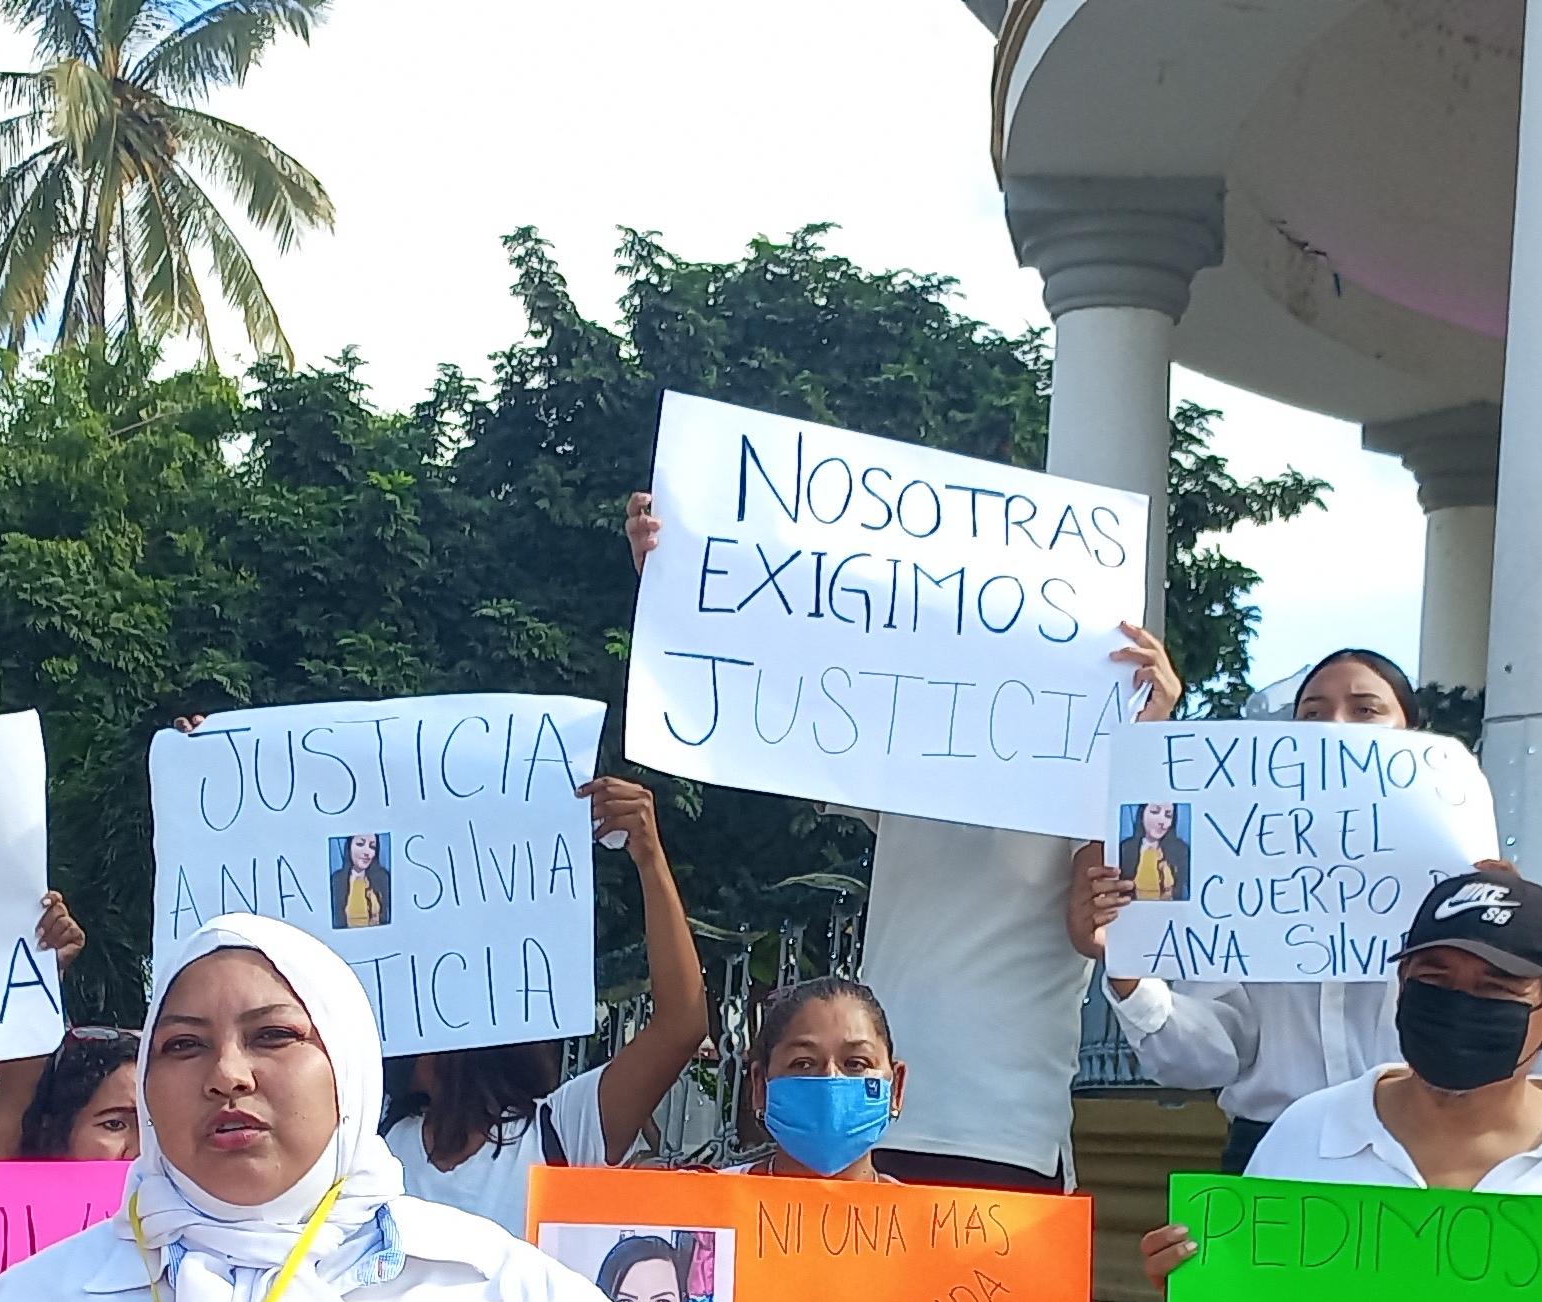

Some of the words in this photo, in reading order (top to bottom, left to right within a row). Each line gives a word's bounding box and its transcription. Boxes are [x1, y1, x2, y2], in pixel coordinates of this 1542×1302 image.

[738, 432, 1126, 568] NOSOTRAS
[699, 537, 1079, 643] EXIGIMOS
[664, 651, 1123, 763] JUSTICIA
[188, 713, 581, 831] JUSTICIA
[1163, 732, 1467, 806] EXIGIMOS
[1204, 803, 1315, 860] VER
[1338, 803, 1396, 860] EL
[170, 853, 314, 939] ANA
[405, 820, 577, 911] SILVIA
[1201, 864, 1401, 919] CUERPO
[1481, 907, 1514, 925] SB
[1143, 920, 1251, 980] ANA
[758, 1200, 803, 1259] NI
[820, 1203, 908, 1258] UNA
[930, 1200, 1010, 1257] MAS
[1187, 1186, 1542, 1288] PEDIMOS
